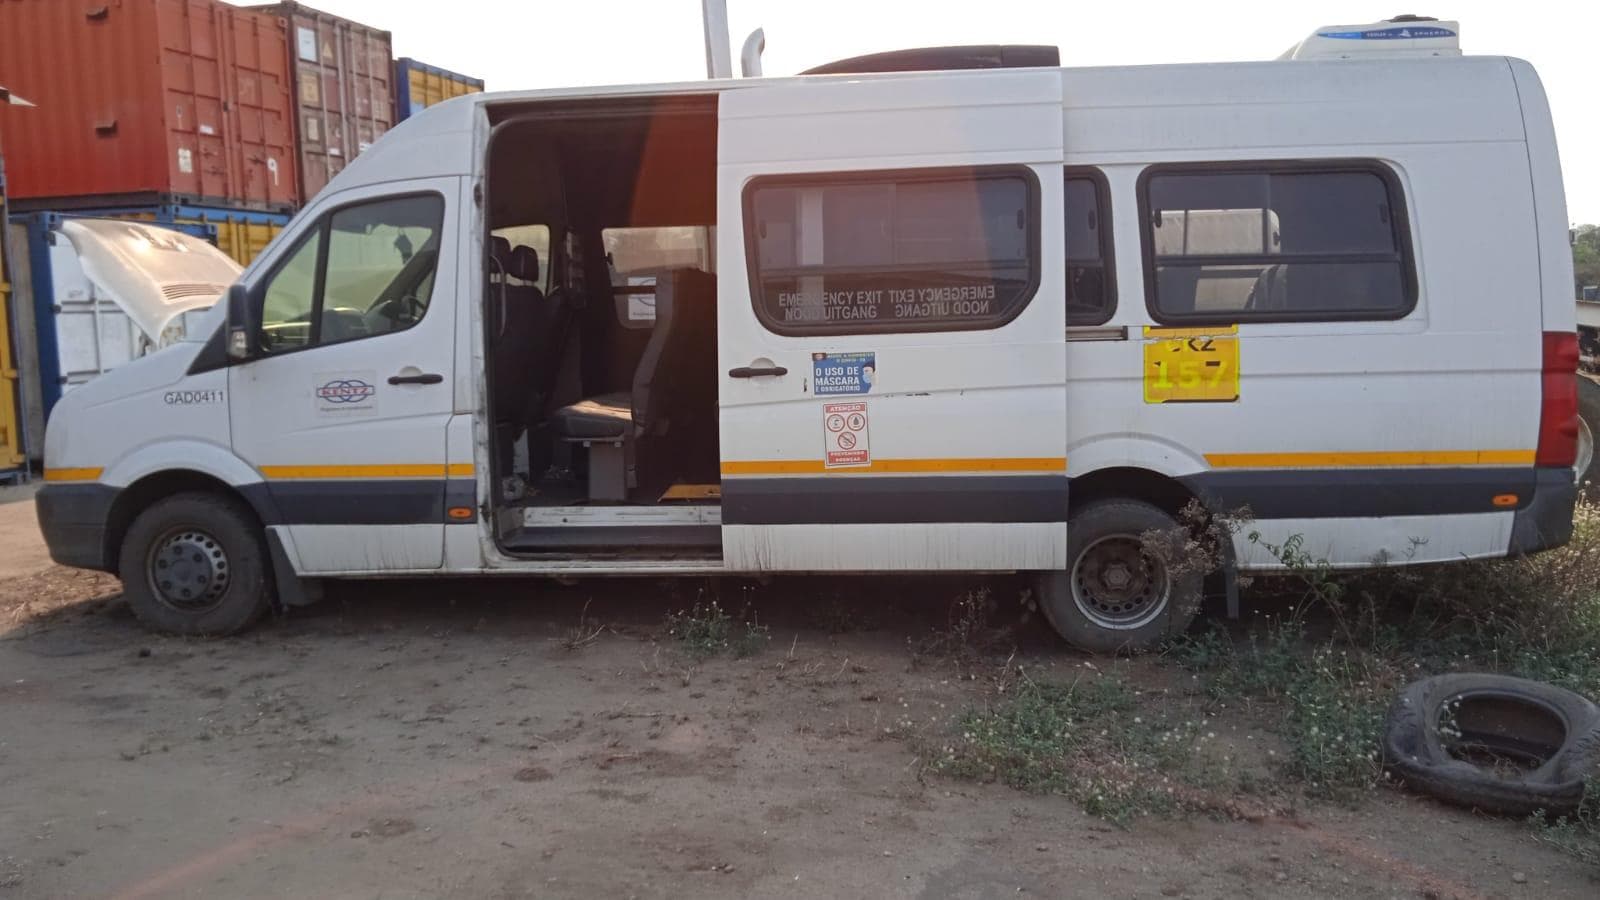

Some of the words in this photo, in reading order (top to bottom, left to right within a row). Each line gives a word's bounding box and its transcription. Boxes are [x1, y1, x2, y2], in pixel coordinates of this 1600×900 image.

[857, 290, 882, 305] EXIT
[823, 305, 877, 320] UITGANG
[815, 367, 822, 376] O
[825, 367, 844, 376] USO
[847, 366, 859, 375] DE
[1152, 360, 1228, 389] 157
[164, 391, 223, 404] GAD0411
